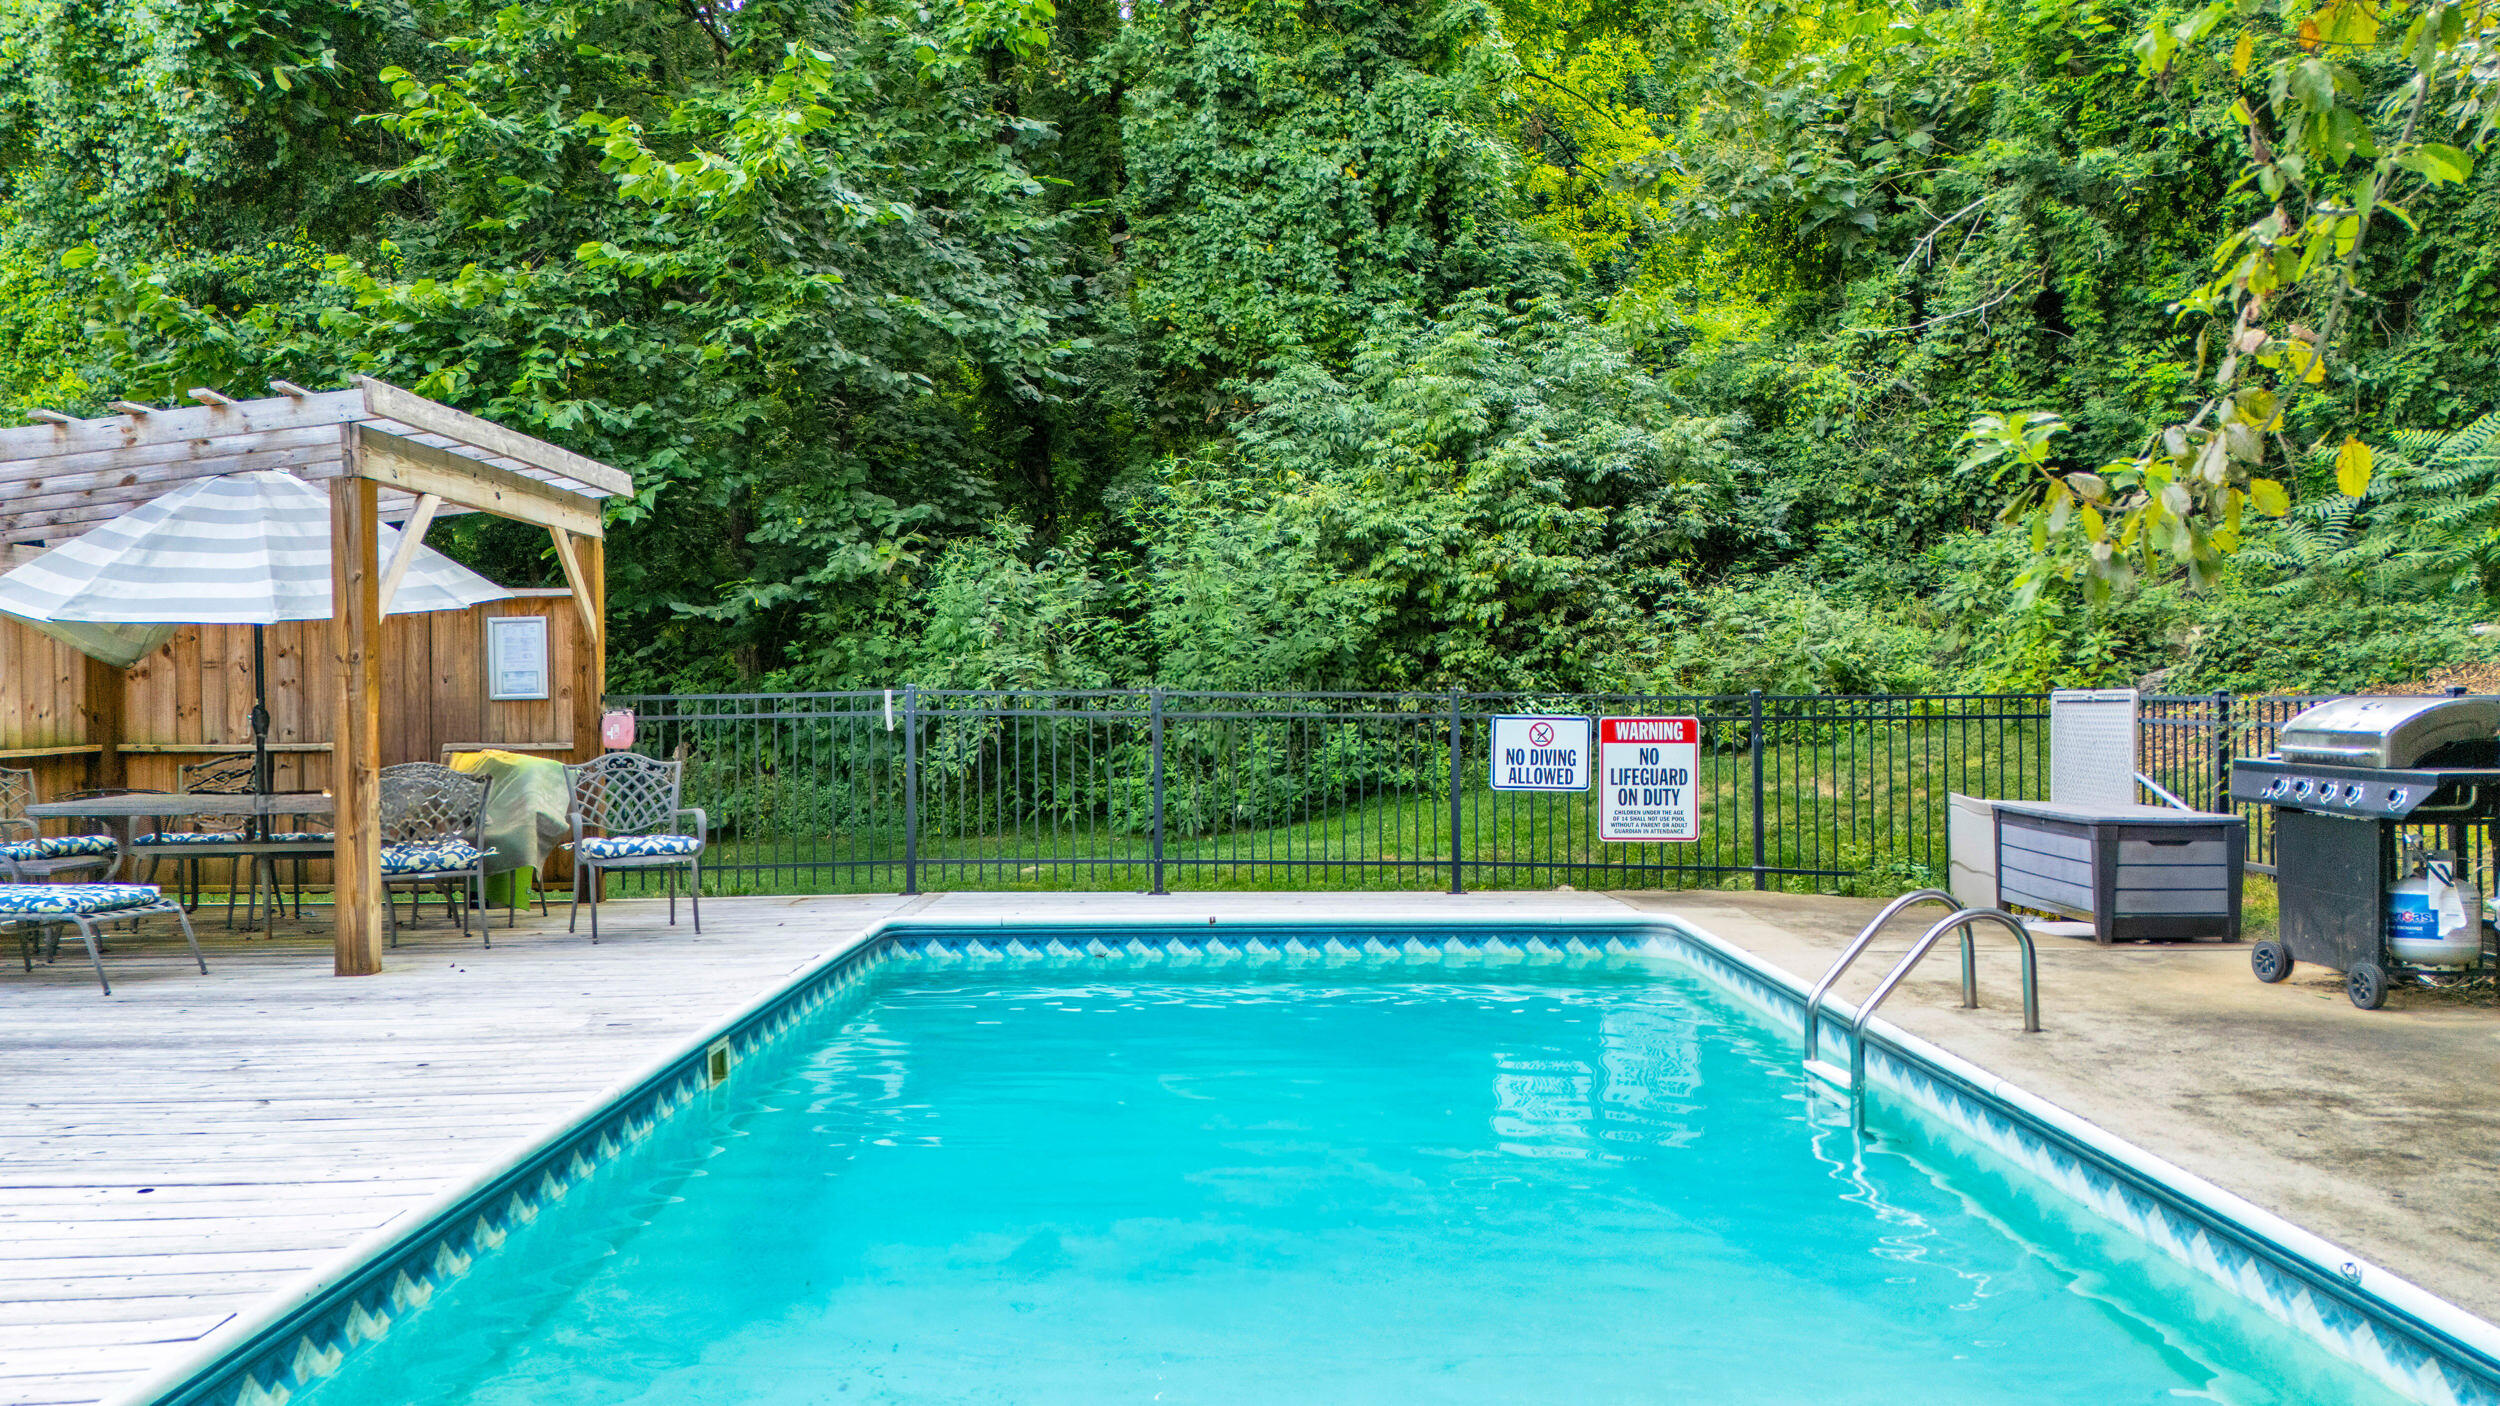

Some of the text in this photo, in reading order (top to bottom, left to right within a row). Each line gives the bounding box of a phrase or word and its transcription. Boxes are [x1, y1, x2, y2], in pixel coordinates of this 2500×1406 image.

[1615, 721, 1684, 741] WARNING
[1506, 748, 1577, 767] NO DIVING
[1639, 747, 1660, 766] NO
[1508, 767, 1574, 785] ALLOWED
[1610, 767, 1688, 786] LIFEGUARD
[1618, 788, 1681, 806] ON DUTY
